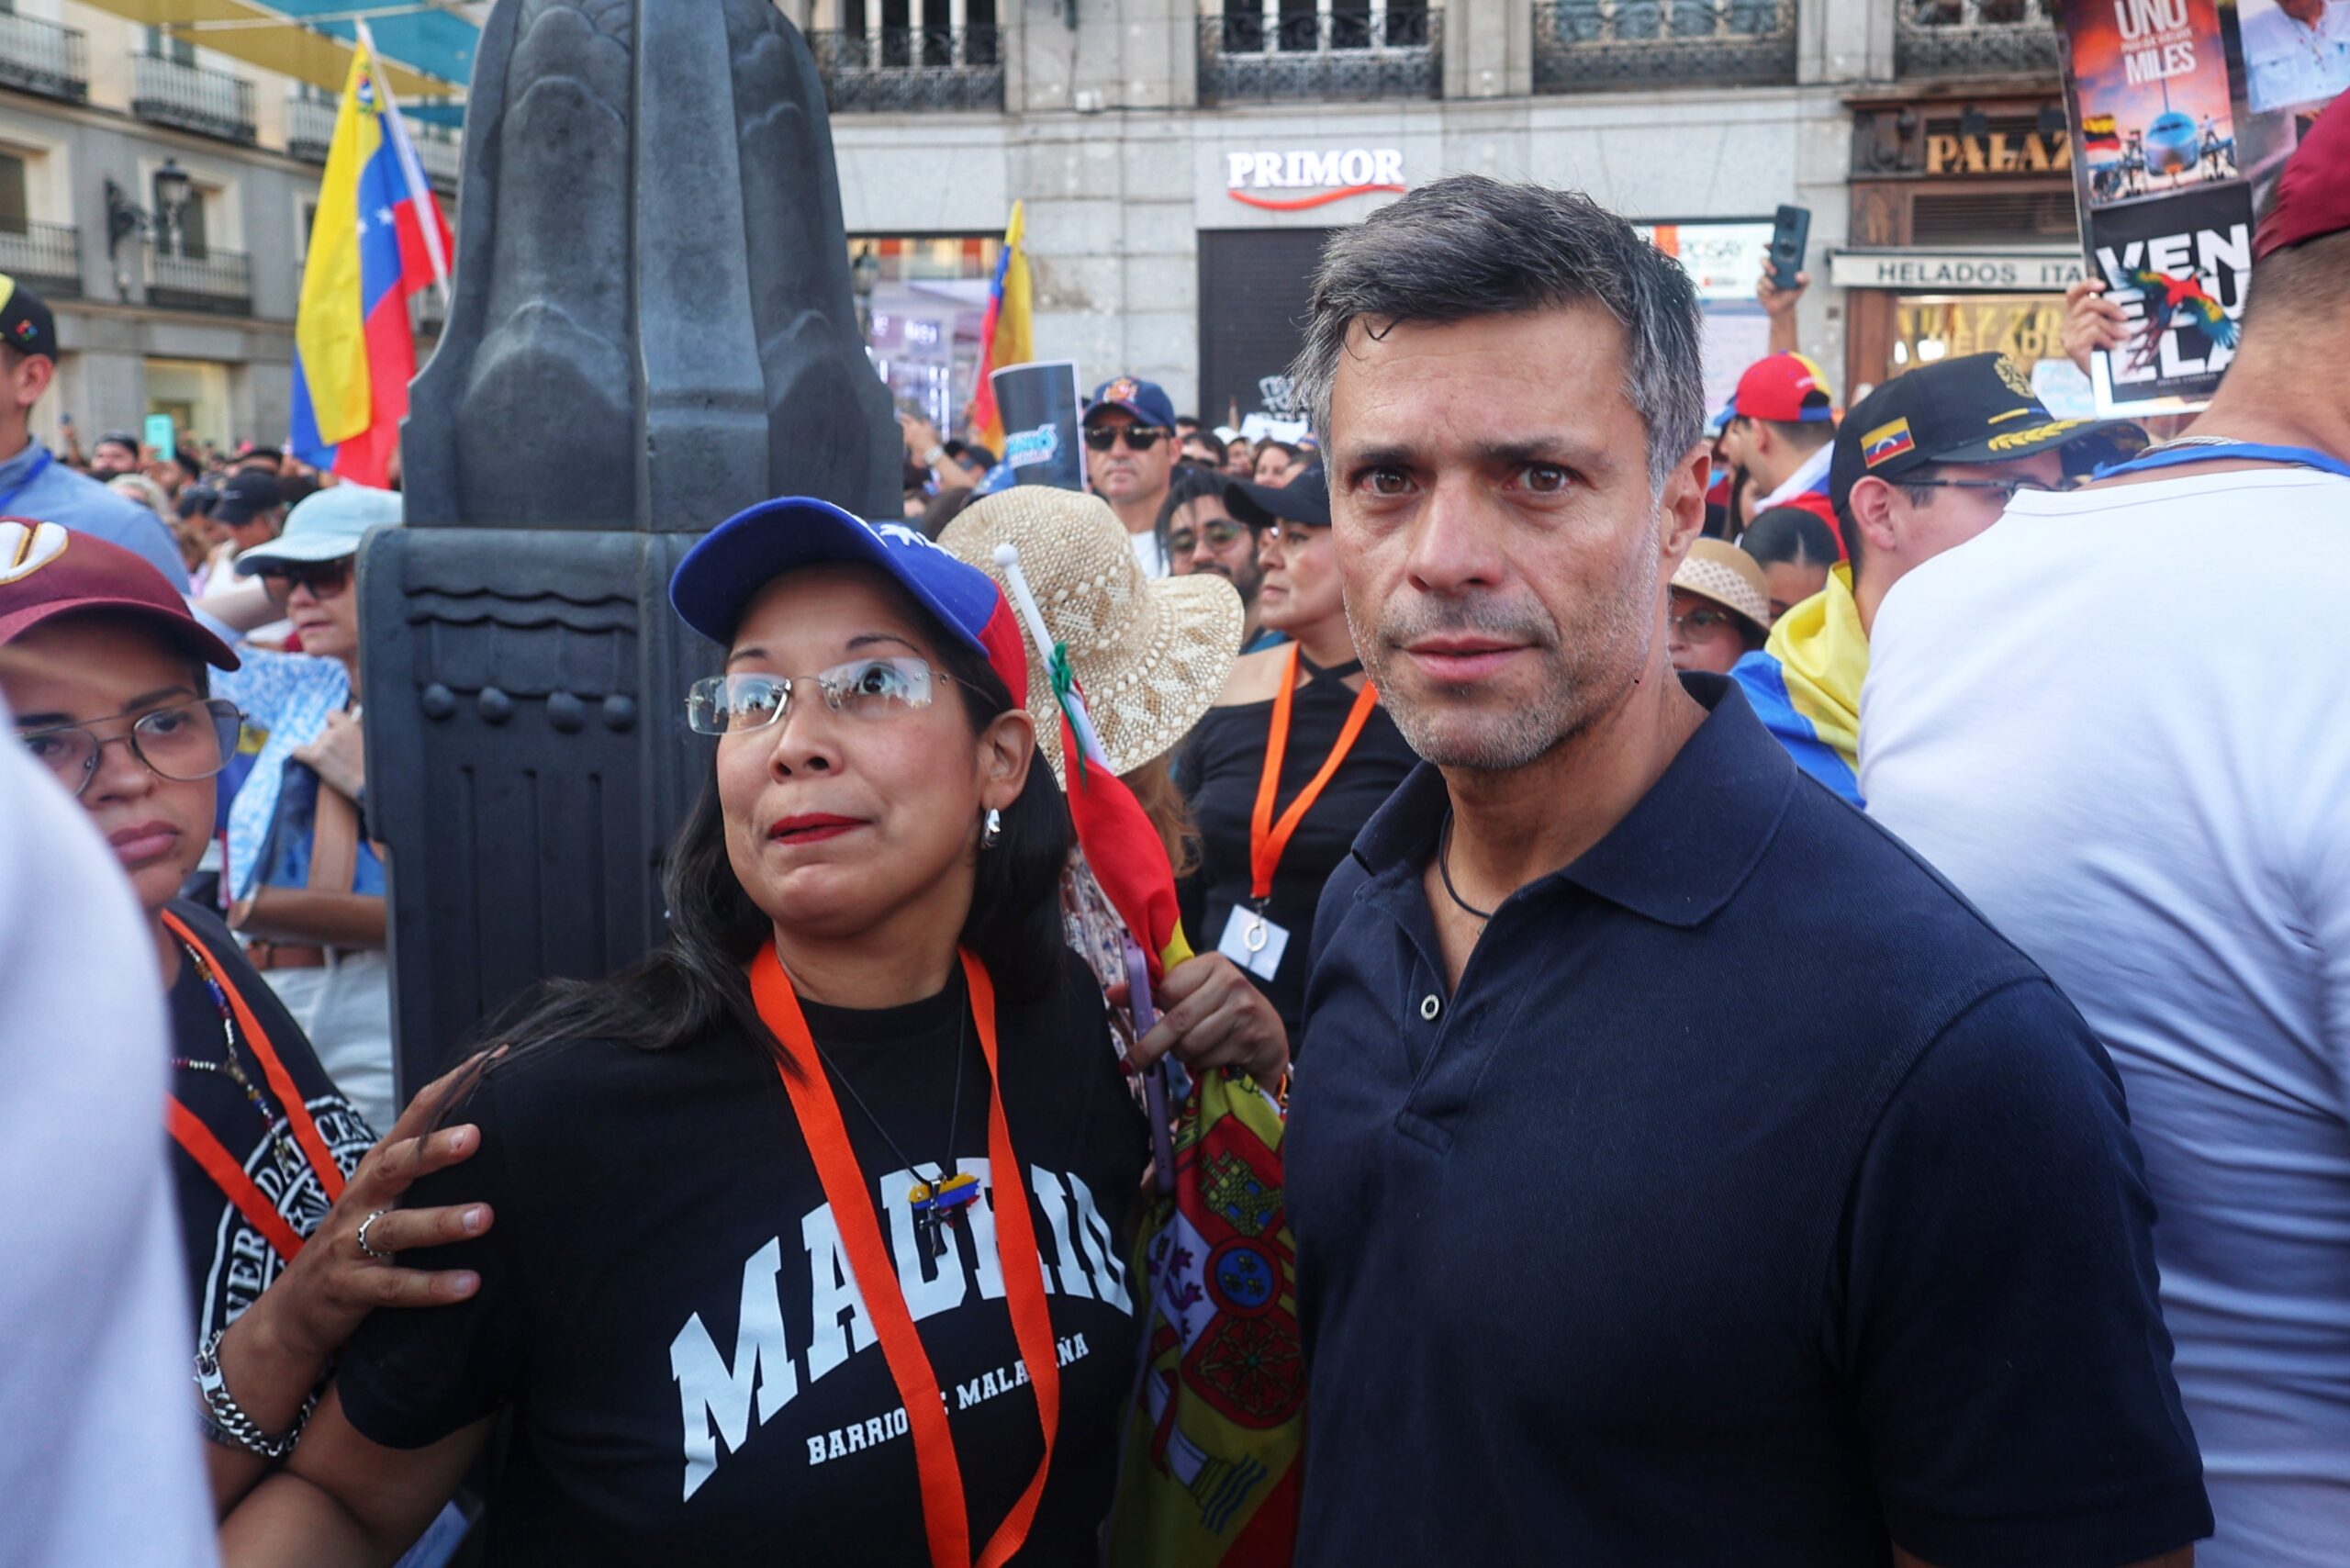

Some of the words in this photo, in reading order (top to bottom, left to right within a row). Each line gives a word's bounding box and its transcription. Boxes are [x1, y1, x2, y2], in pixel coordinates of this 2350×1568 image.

[2123, 40, 2197, 86] MILES
[1226, 149, 1406, 187] PRIMOR
[1877, 263, 2017, 283] HELADOS
[2095, 223, 2252, 291] VEN
[806, 1406, 911, 1466] BARRIO
[956, 1331, 1091, 1410] MALAÑA
